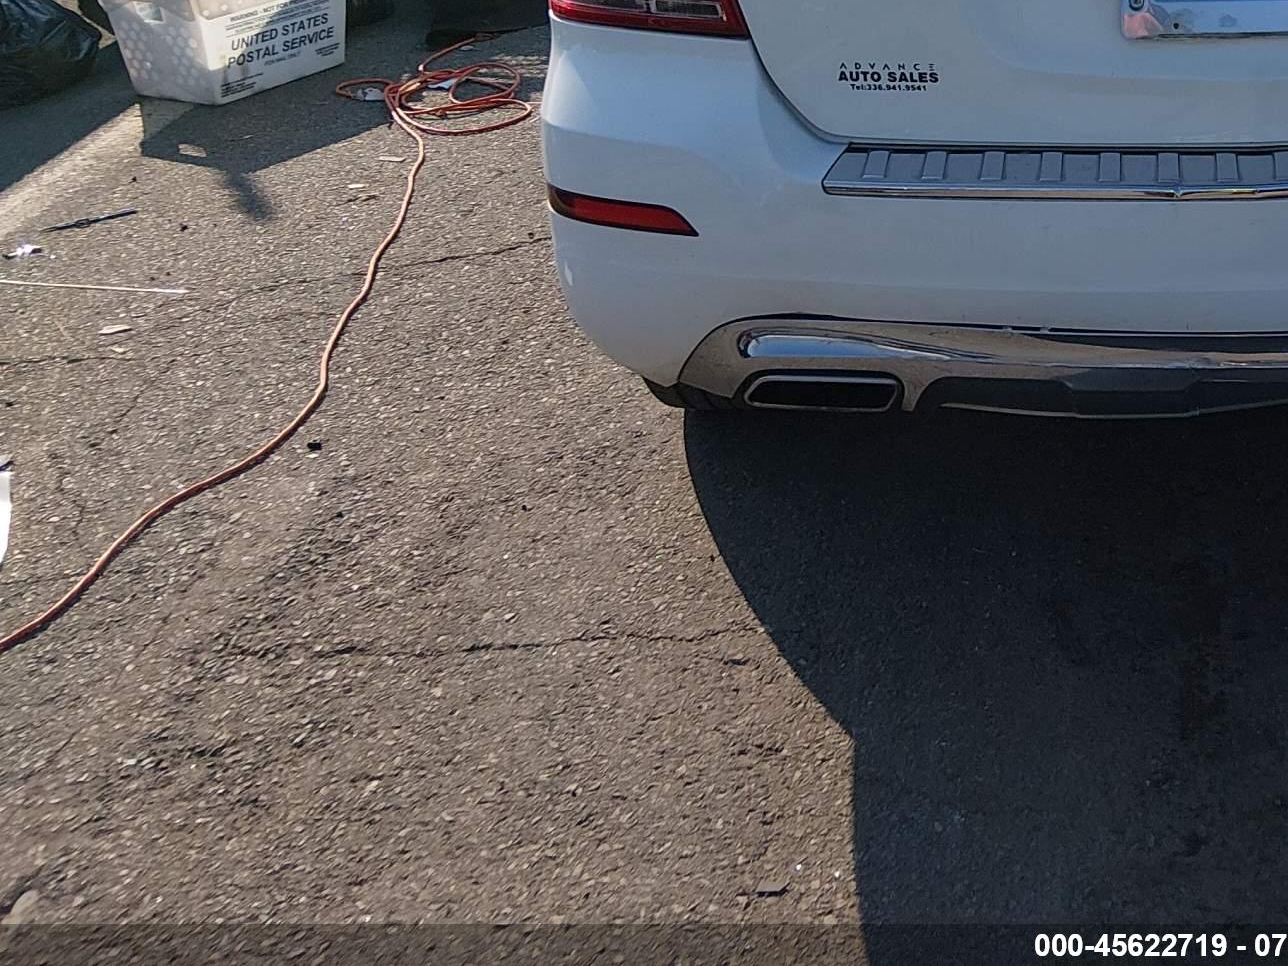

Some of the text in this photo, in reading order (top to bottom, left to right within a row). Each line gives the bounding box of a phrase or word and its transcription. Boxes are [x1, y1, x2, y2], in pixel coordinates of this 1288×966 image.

[227, 44, 279, 69] POSTAL
[282, 26, 335, 52] SERVICE
[231, 28, 279, 51] UNITED
[281, 13, 329, 36] STATES
[838, 71, 939, 83] AUTO SALES
